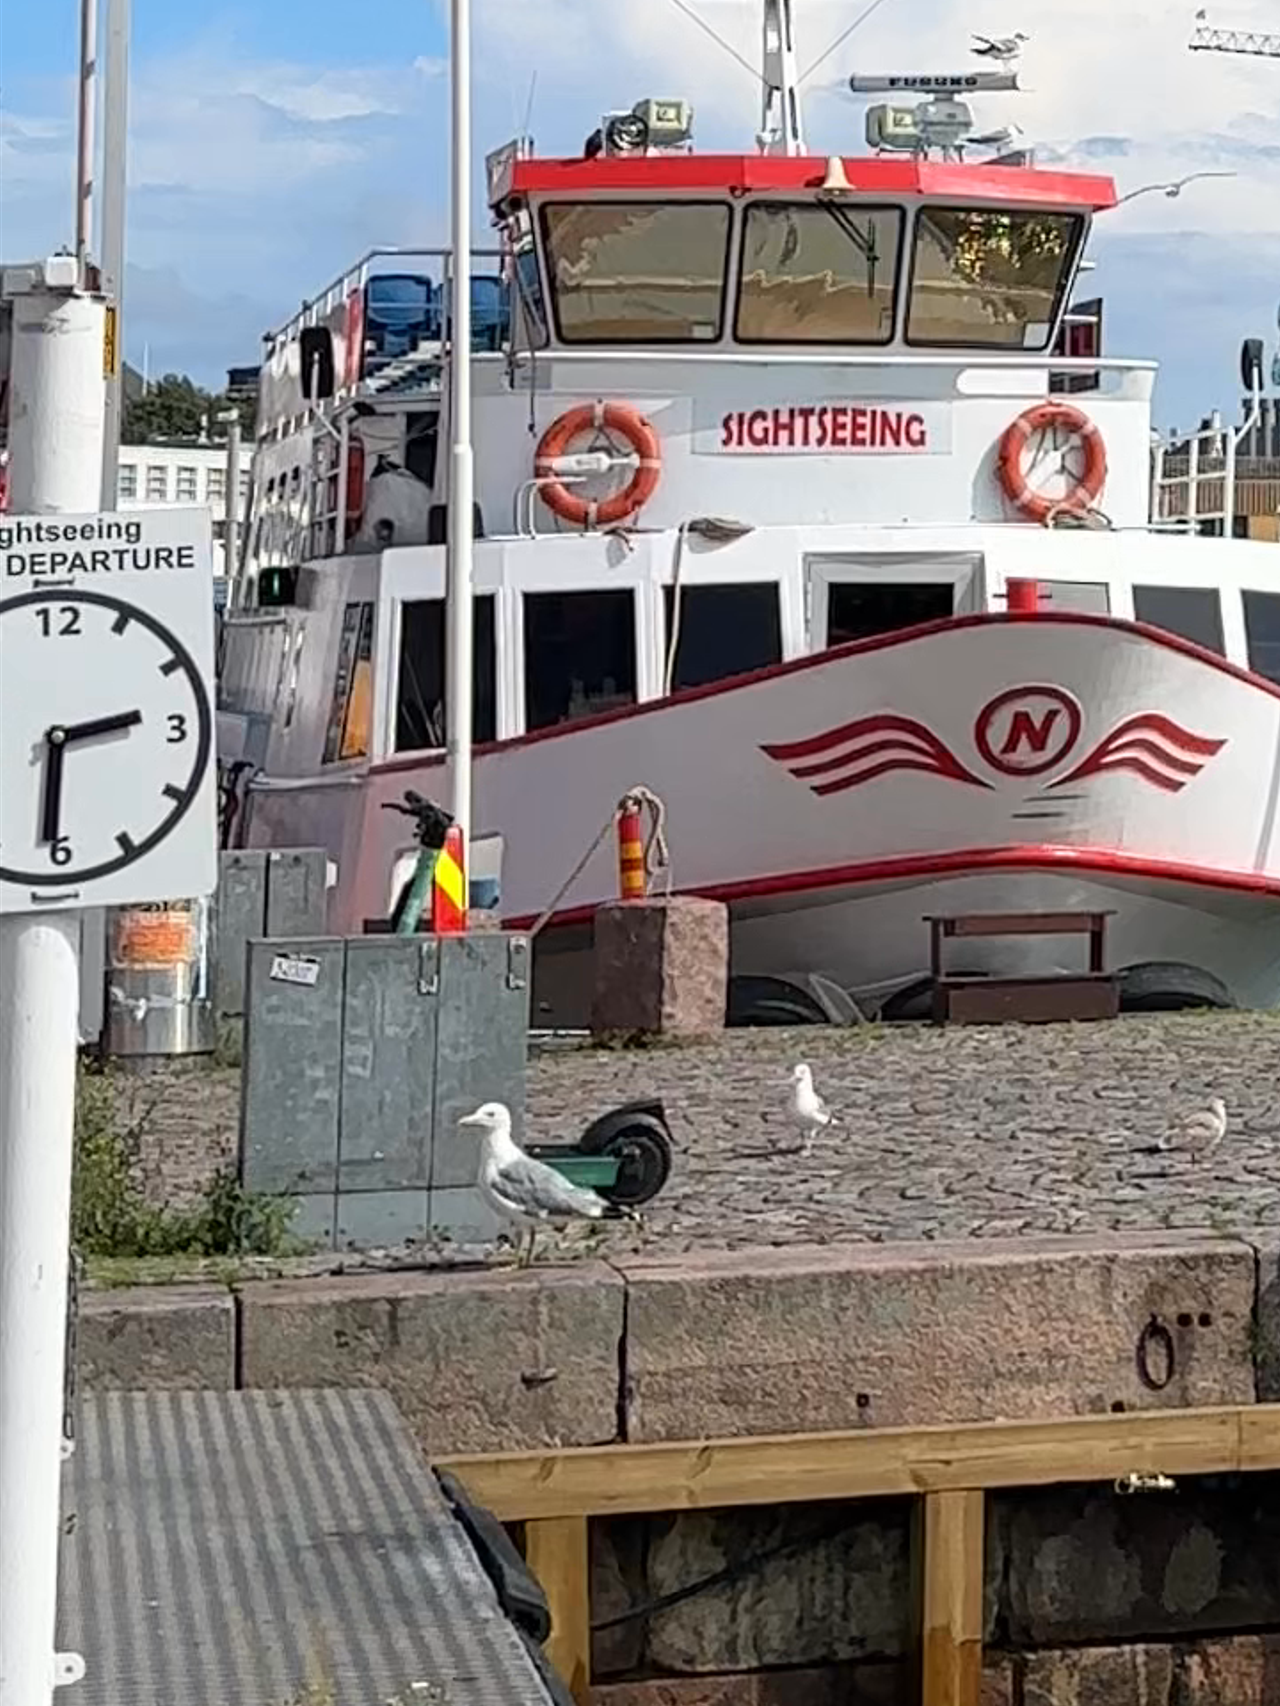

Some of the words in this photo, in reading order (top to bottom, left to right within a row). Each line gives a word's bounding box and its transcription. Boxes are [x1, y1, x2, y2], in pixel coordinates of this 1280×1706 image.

[721, 406, 926, 448] SIGHTSEEING
[6, 545, 195, 576] DEPARTURE
[35, 606, 82, 637] 12
[166, 714, 187, 743] 3
[1000, 708, 1061, 754] N
[50, 836, 72, 866] 6
